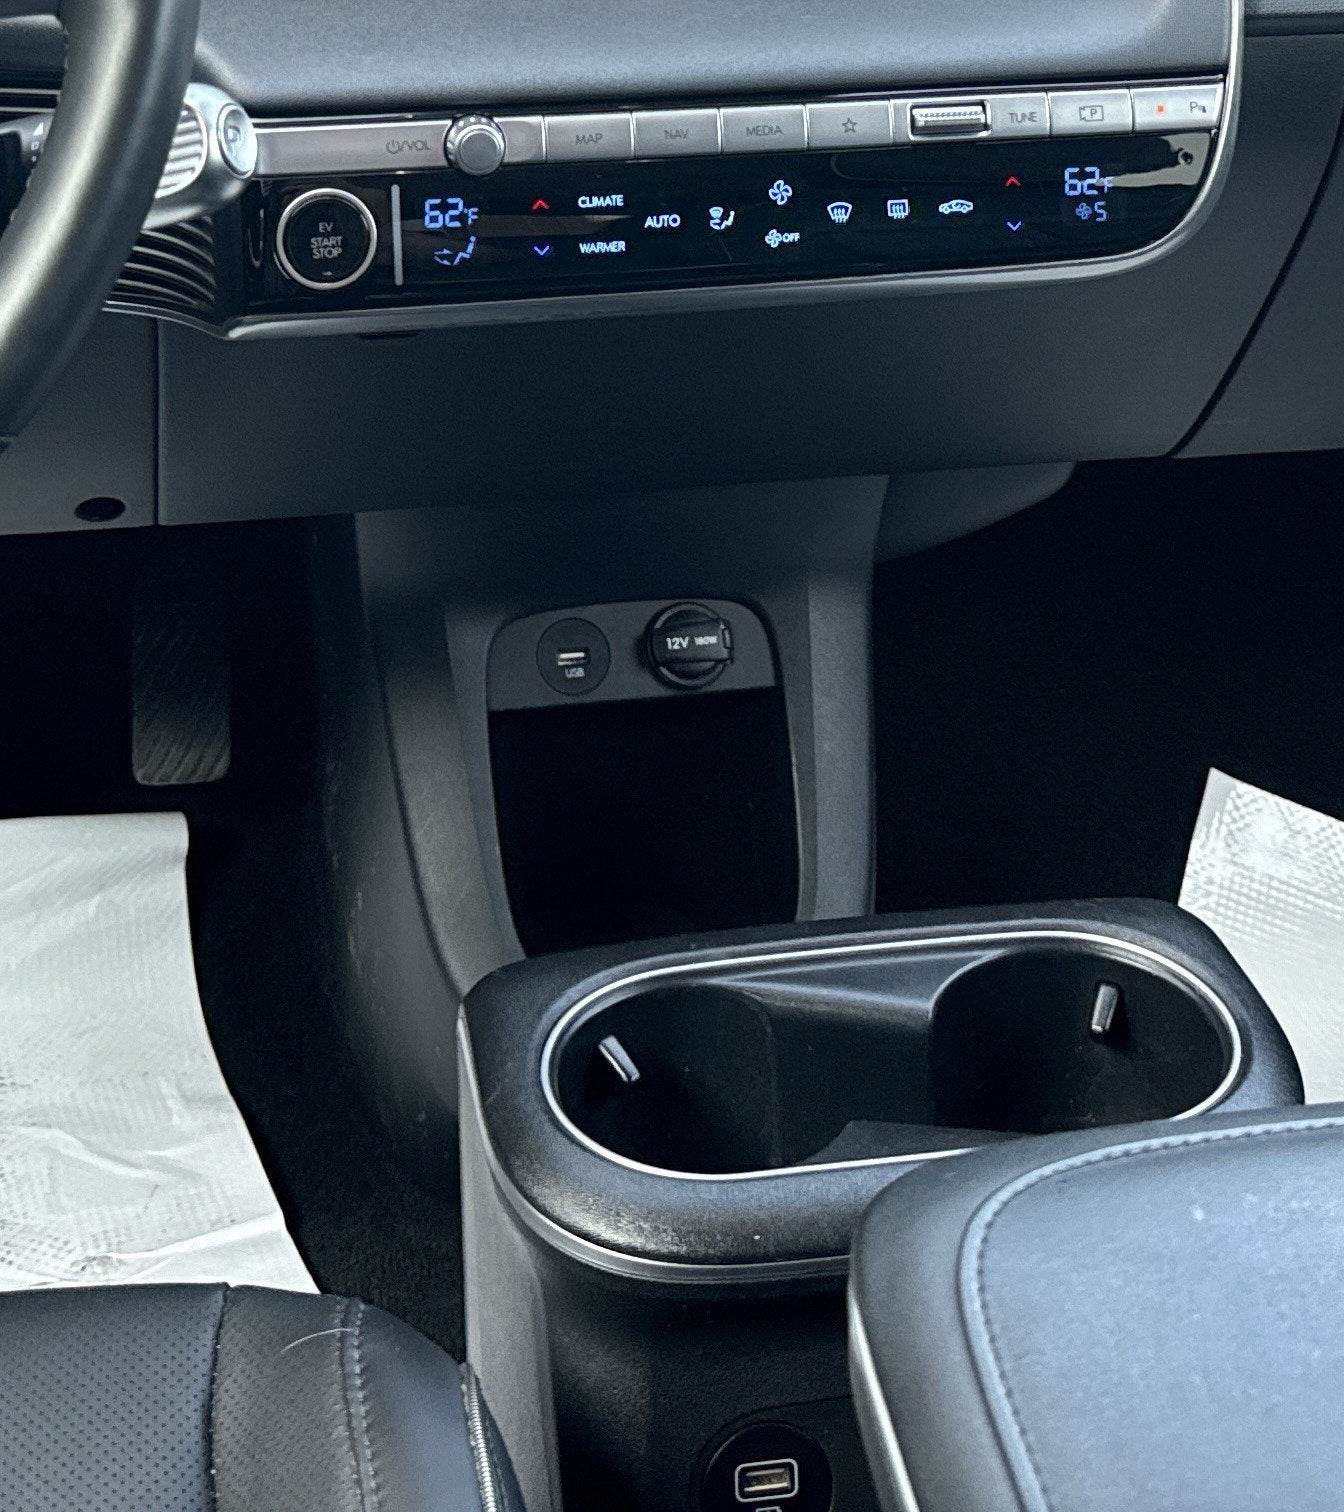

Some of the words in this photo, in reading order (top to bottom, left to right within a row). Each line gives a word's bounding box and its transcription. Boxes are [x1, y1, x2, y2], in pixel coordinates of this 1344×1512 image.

[1009, 112, 1037, 124] TUNE
[664, 129, 688, 141] NAV
[746, 125, 784, 137] MEDIA
[576, 133, 603, 145] MAP
[577, 195, 624, 208] CLIMATE
[1095, 201, 1107, 221] 5
[645, 214, 681, 228] AUTO
[319, 222, 333, 233] EV
[310, 236, 343, 248] START
[782, 232, 800, 243] OFF
[312, 247, 343, 259] STOP
[579, 240, 626, 254] WARMER
[666, 636, 689, 650] 12V
[565, 668, 585, 678] USB
